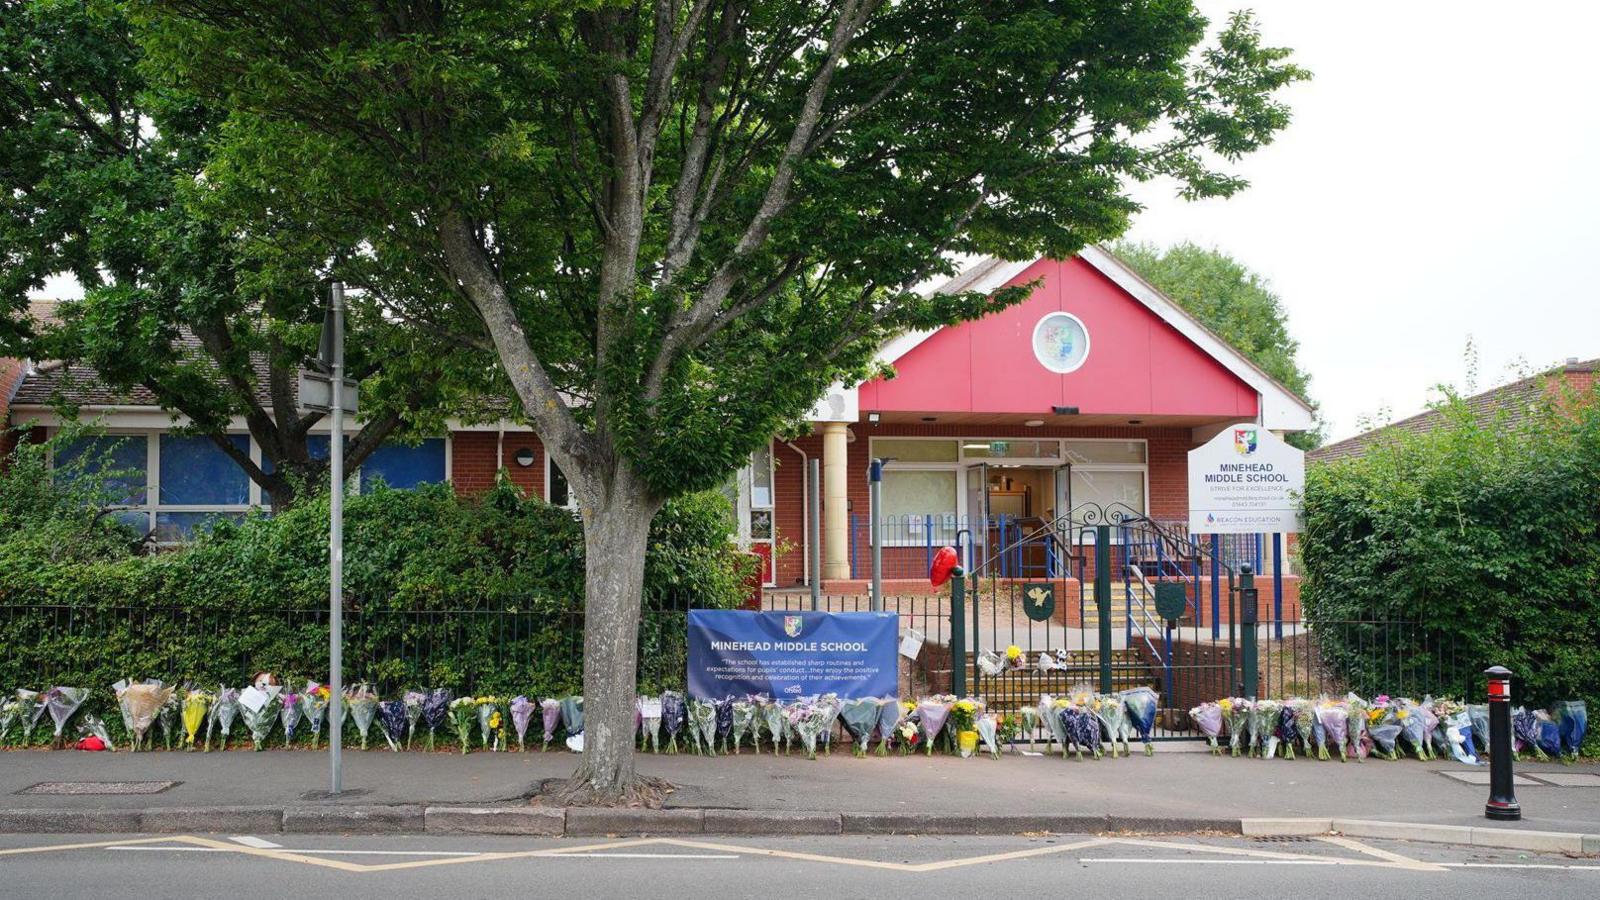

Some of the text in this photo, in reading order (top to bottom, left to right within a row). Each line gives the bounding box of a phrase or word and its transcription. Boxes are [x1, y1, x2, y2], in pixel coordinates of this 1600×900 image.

[1220, 463, 1273, 472] MINEHEAD
[1205, 474, 1289, 482] MIDDLE SCHOOL
[711, 641, 868, 652] MINEHEAD MIDDLE SCHOOL
